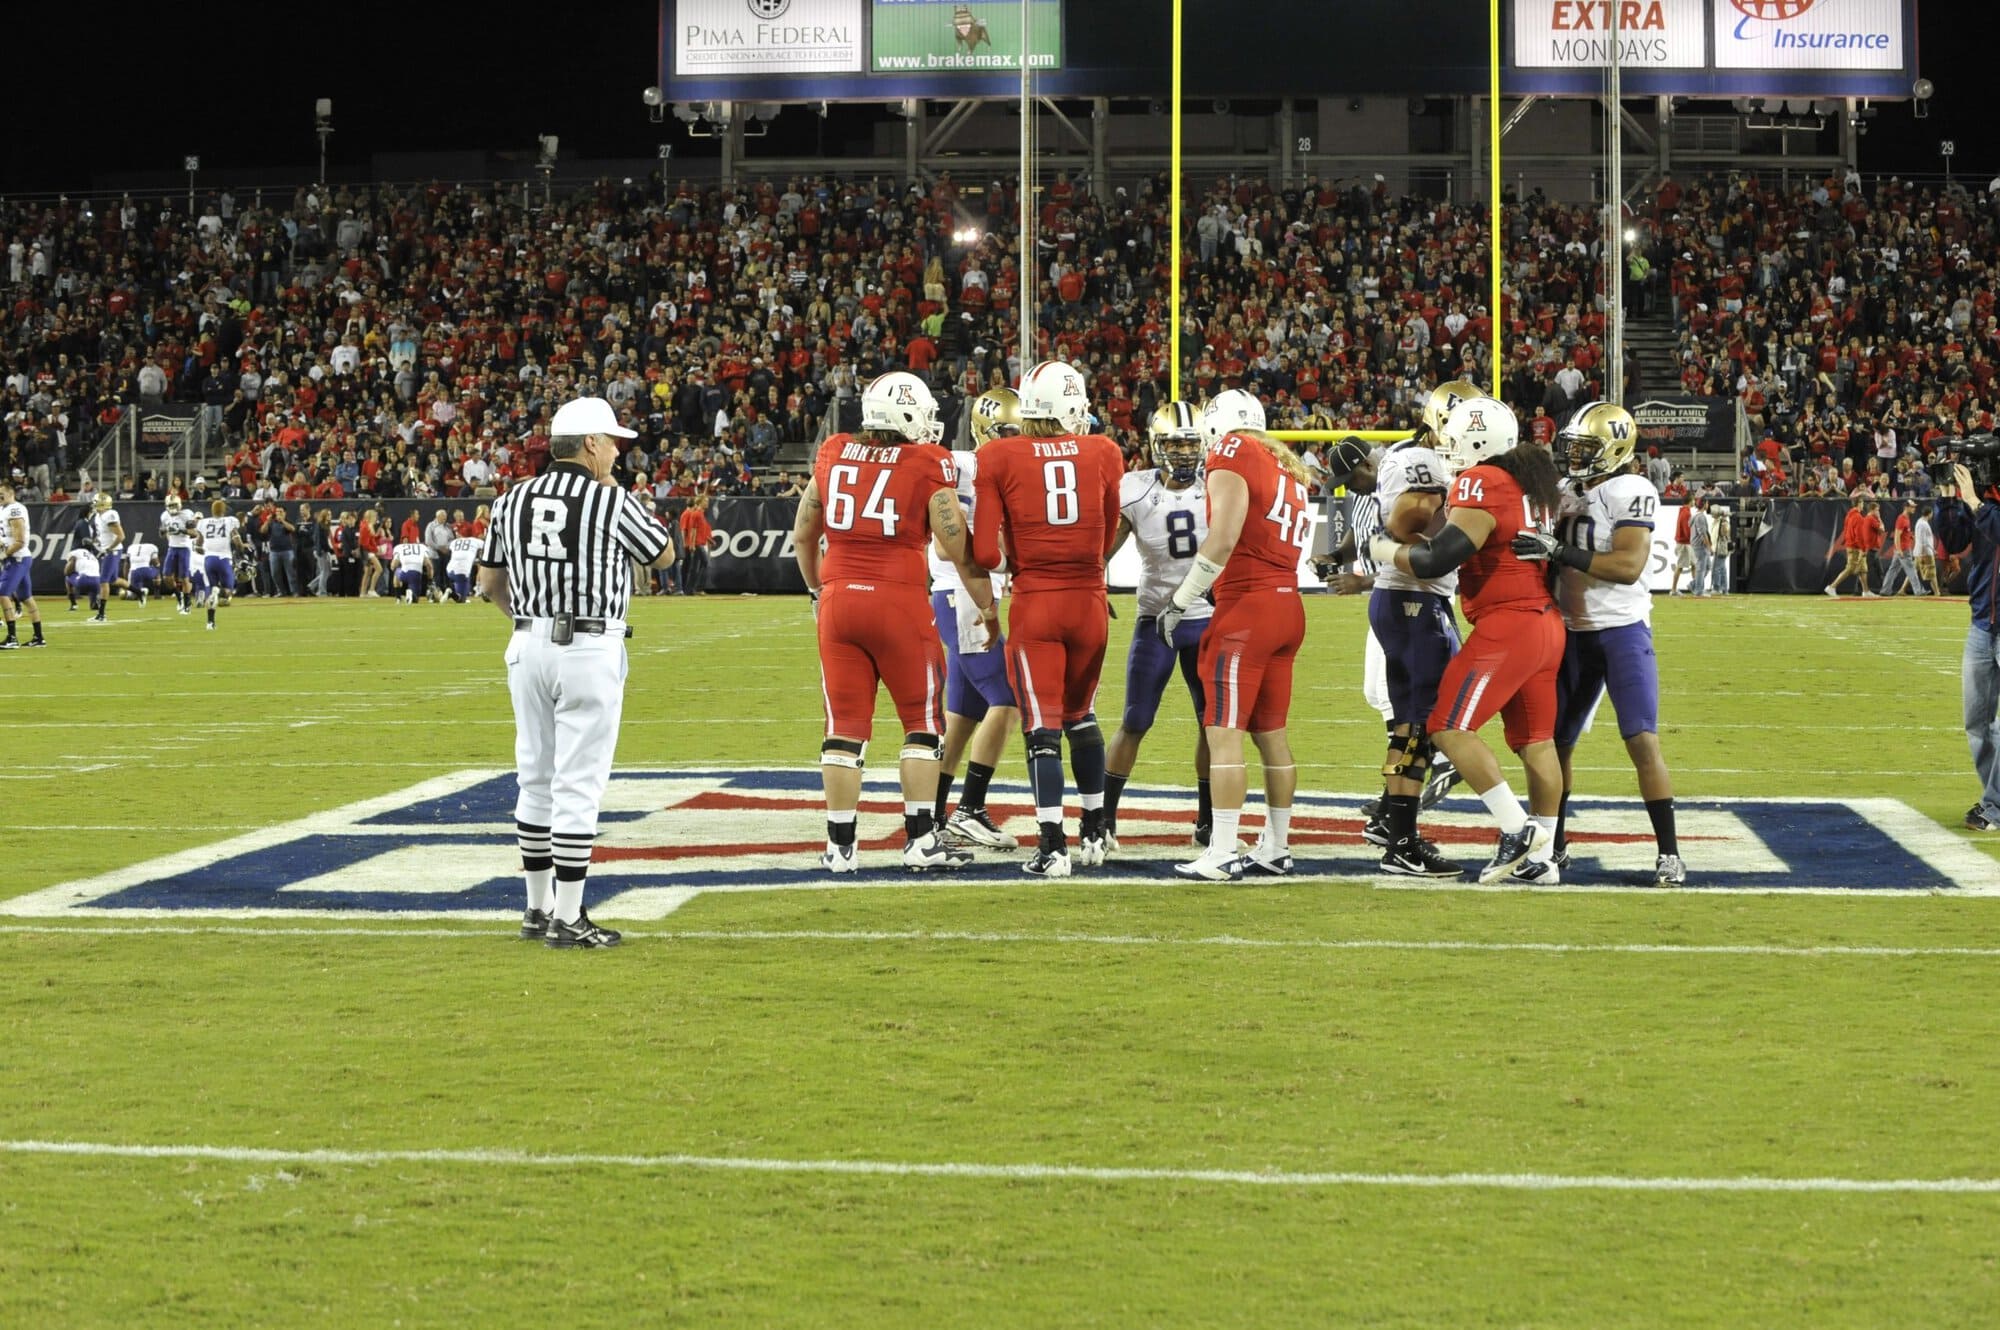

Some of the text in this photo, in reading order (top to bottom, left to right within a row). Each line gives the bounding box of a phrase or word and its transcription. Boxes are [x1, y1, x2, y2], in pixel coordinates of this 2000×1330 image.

[1552, 1, 1665, 30] EXTRA
[687, 23, 853, 46] PIMA FEDERAL
[1774, 29, 1889, 48] Insurance
[1552, 38, 1668, 62] MONDAYS
[659, 144, 671, 158] 27
[1298, 137, 1311, 151] 28
[1941, 141, 1954, 155] 29
[1466, 411, 1486, 431] A
[1635, 409, 1707, 417] AMERICAN FAMILY
[1608, 421, 1630, 440] W
[1032, 440, 1079, 458] FOLES
[1213, 437, 1242, 458] 42
[1405, 464, 1432, 484] 56
[1043, 460, 1080, 525] 8
[1458, 477, 1484, 502] 94
[825, 464, 900, 536] 64
[1628, 496, 1656, 518] 40
[206, 524, 226, 539] 24
[527, 497, 569, 560] R
[1166, 510, 1198, 559] 8
